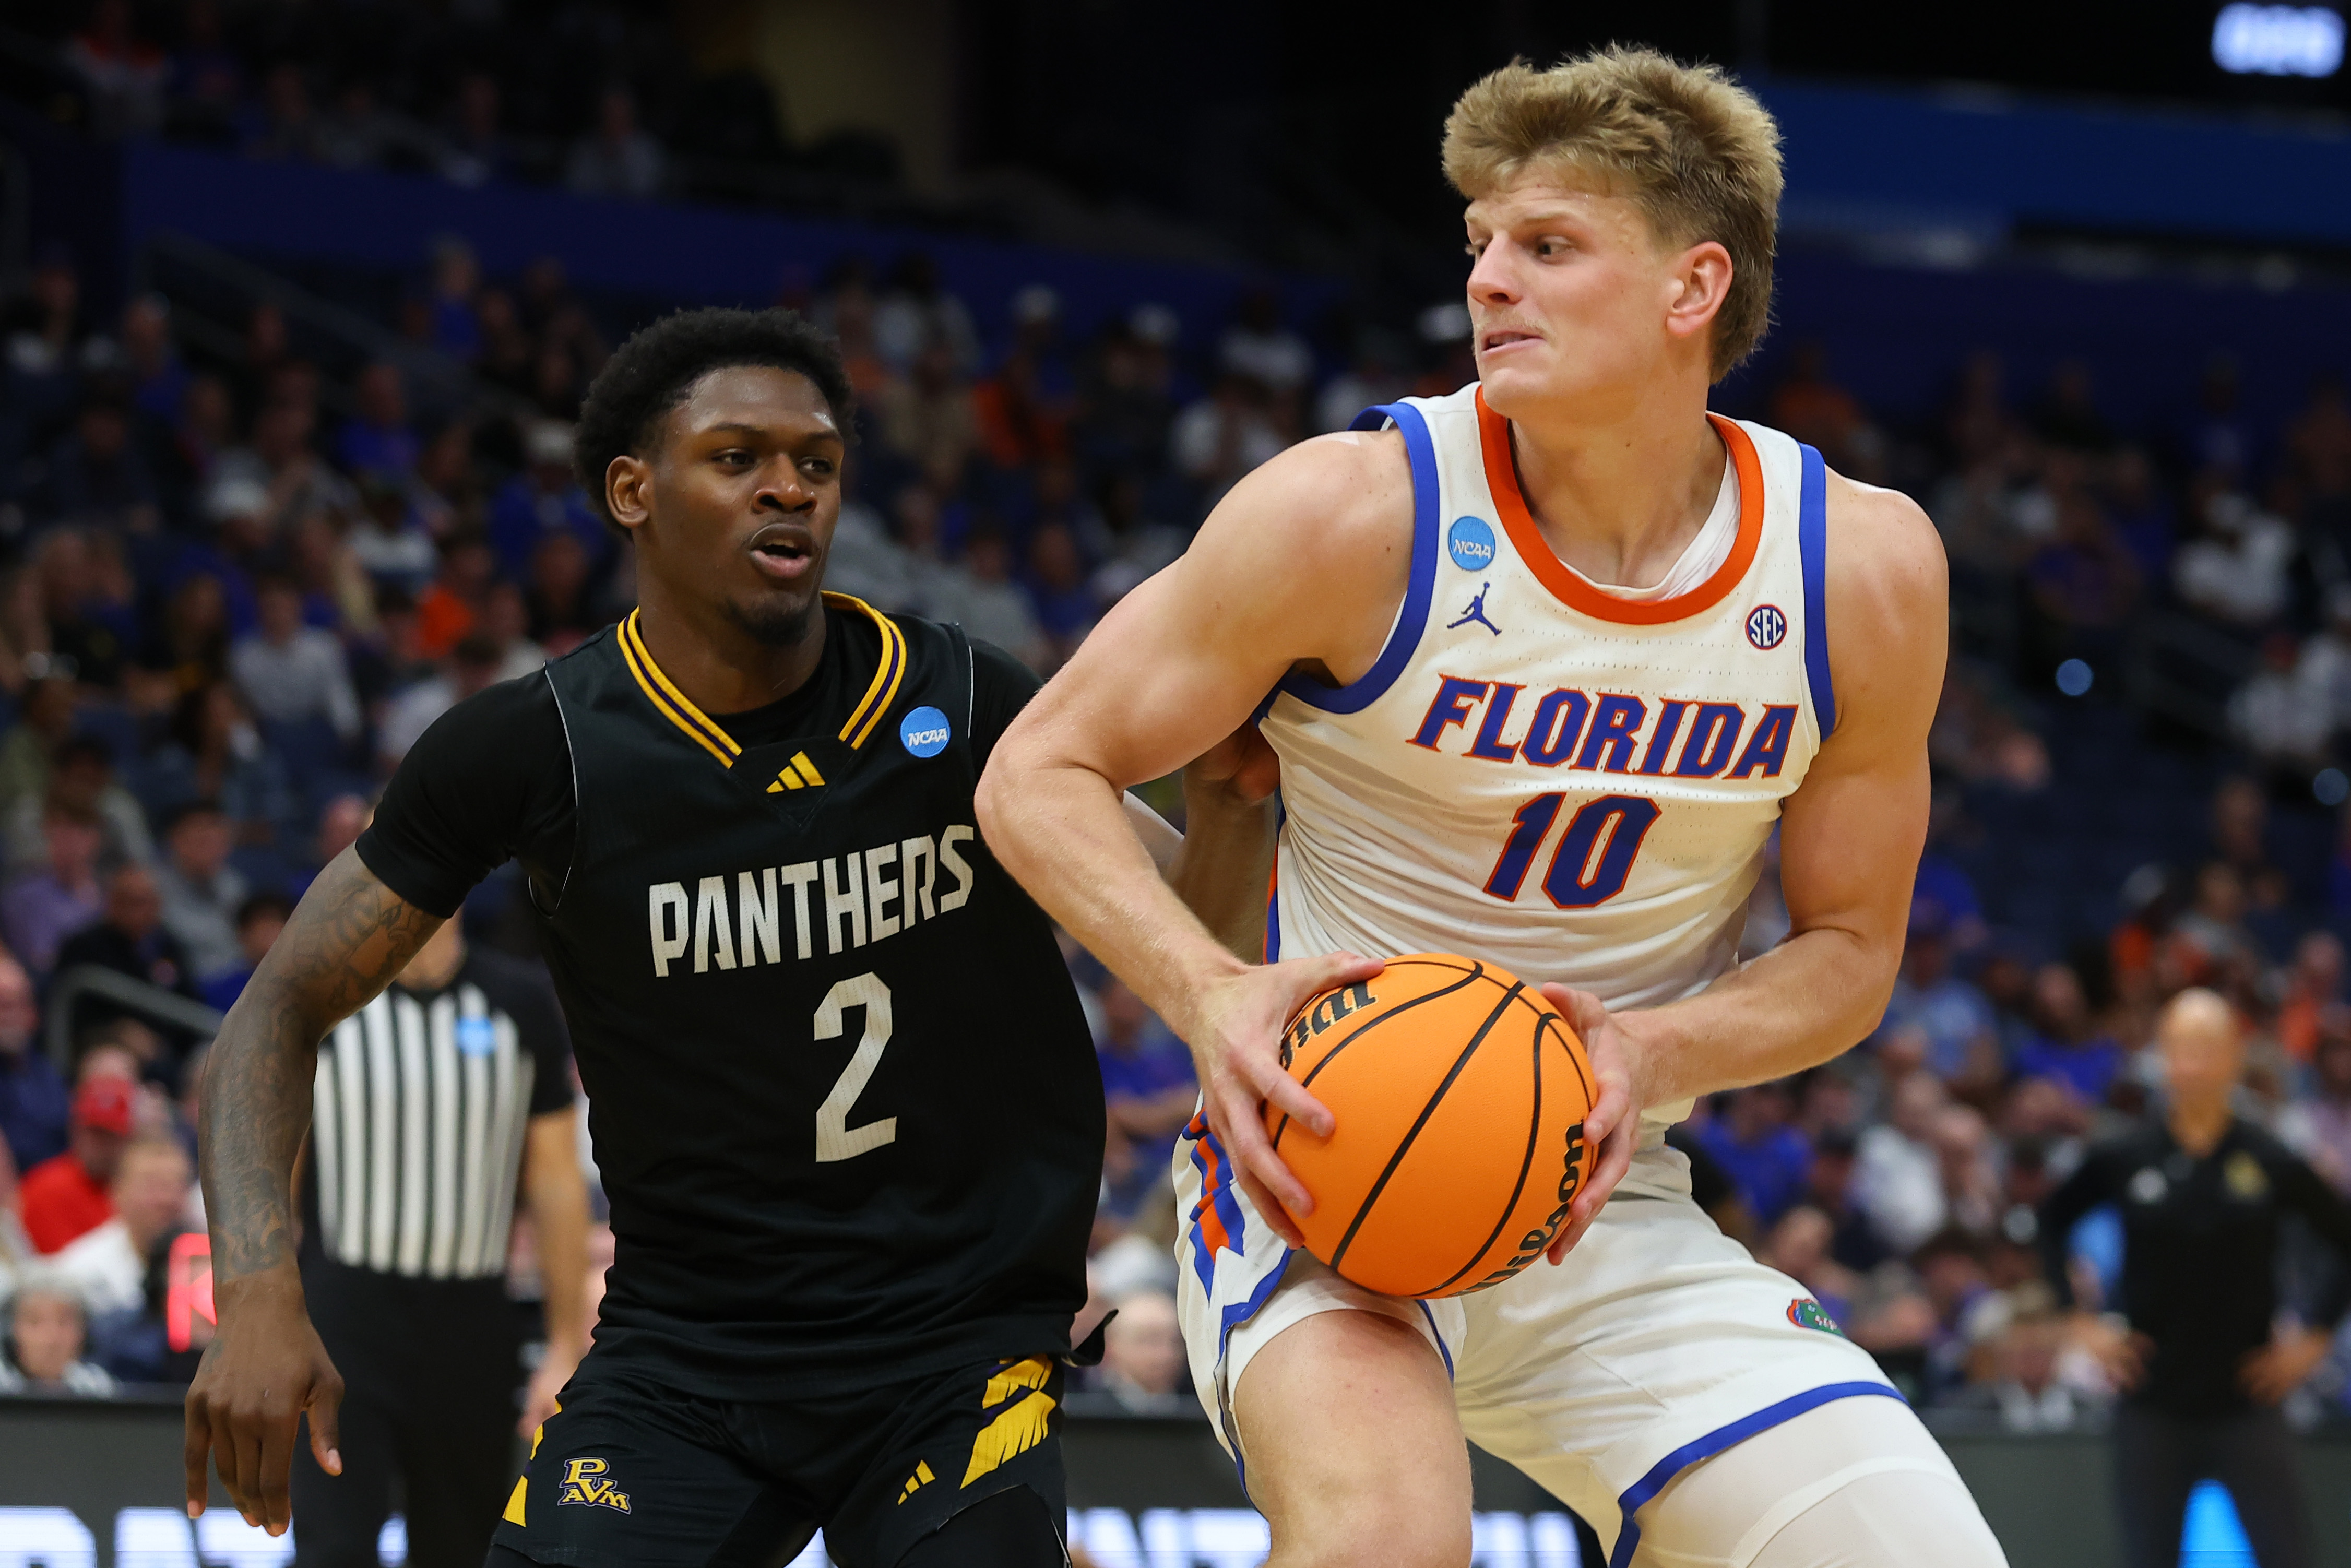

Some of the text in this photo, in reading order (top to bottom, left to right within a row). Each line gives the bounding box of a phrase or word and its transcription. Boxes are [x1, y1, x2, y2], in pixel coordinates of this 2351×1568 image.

[1453, 538, 1492, 560] NCAA
[1749, 608, 1784, 647] SEC
[907, 728, 948, 747] NCAA
[1405, 673, 1799, 780] FLORIDA
[649, 824, 974, 978] PANTHERS
[1482, 791, 1662, 909] 10
[814, 971, 897, 1163] 2
